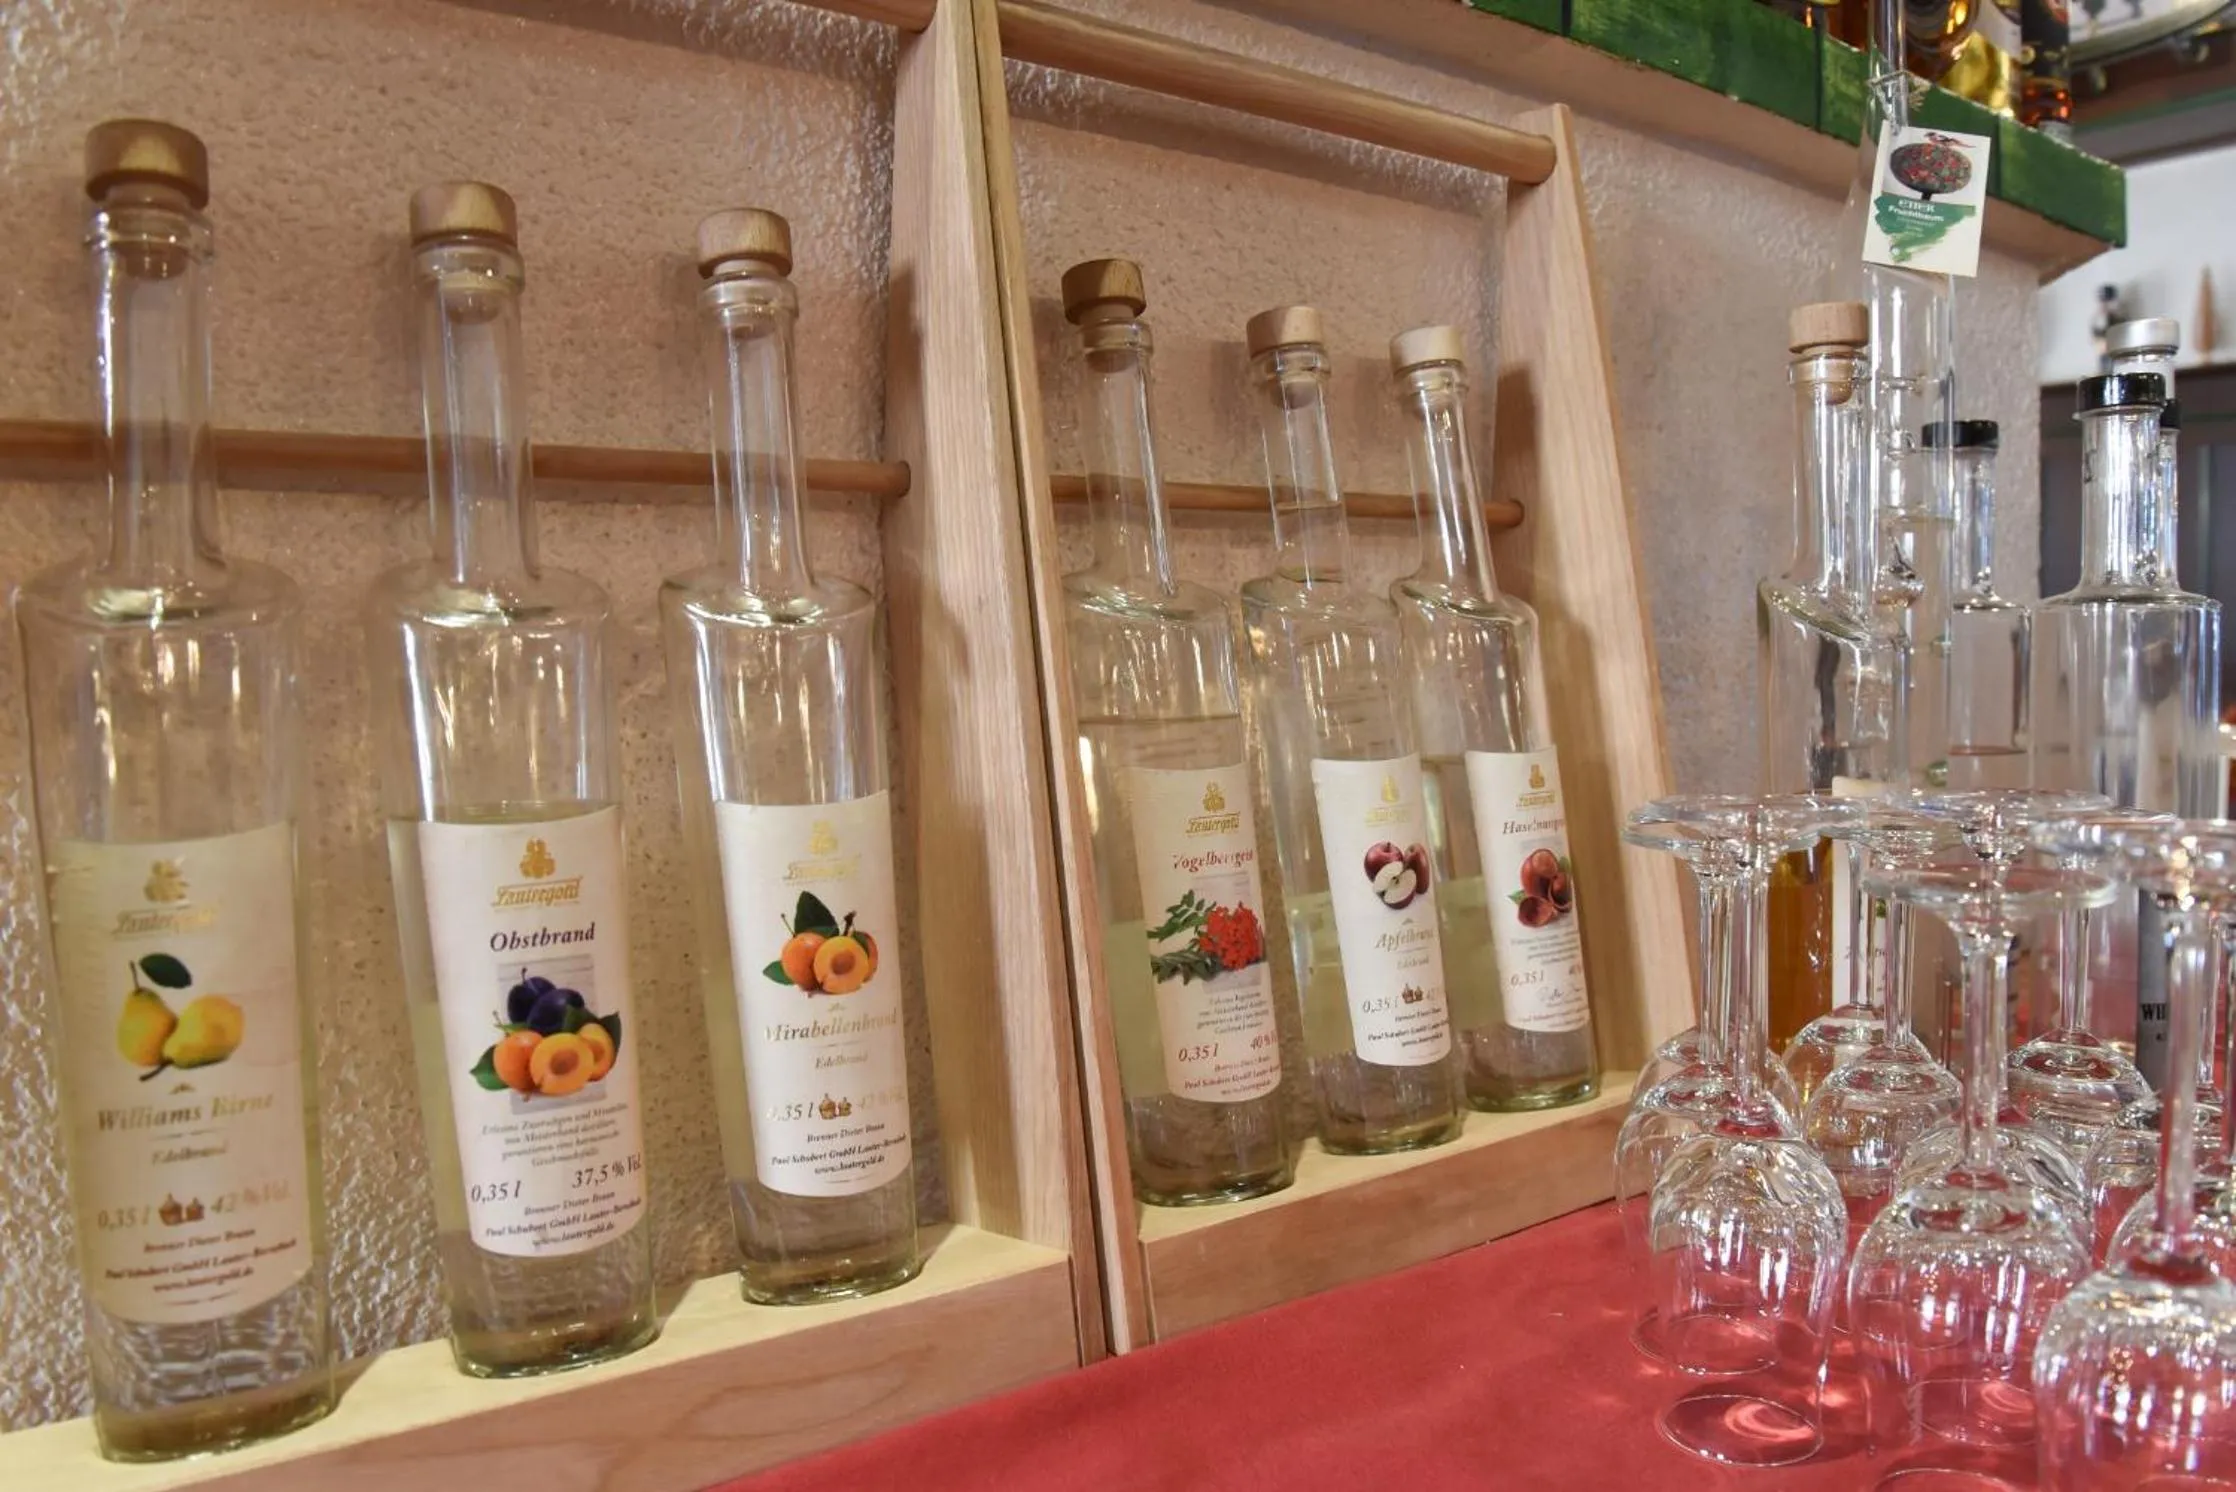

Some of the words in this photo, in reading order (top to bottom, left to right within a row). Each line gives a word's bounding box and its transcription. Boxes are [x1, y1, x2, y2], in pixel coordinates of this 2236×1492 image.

[490, 921, 596, 952] Obstbrand
[1178, 1045, 1209, 1062] 0,35
[97, 1104, 202, 1132] Williams
[470, 1182, 509, 1205] 0,35
[571, 1163, 609, 1190] 37,5
